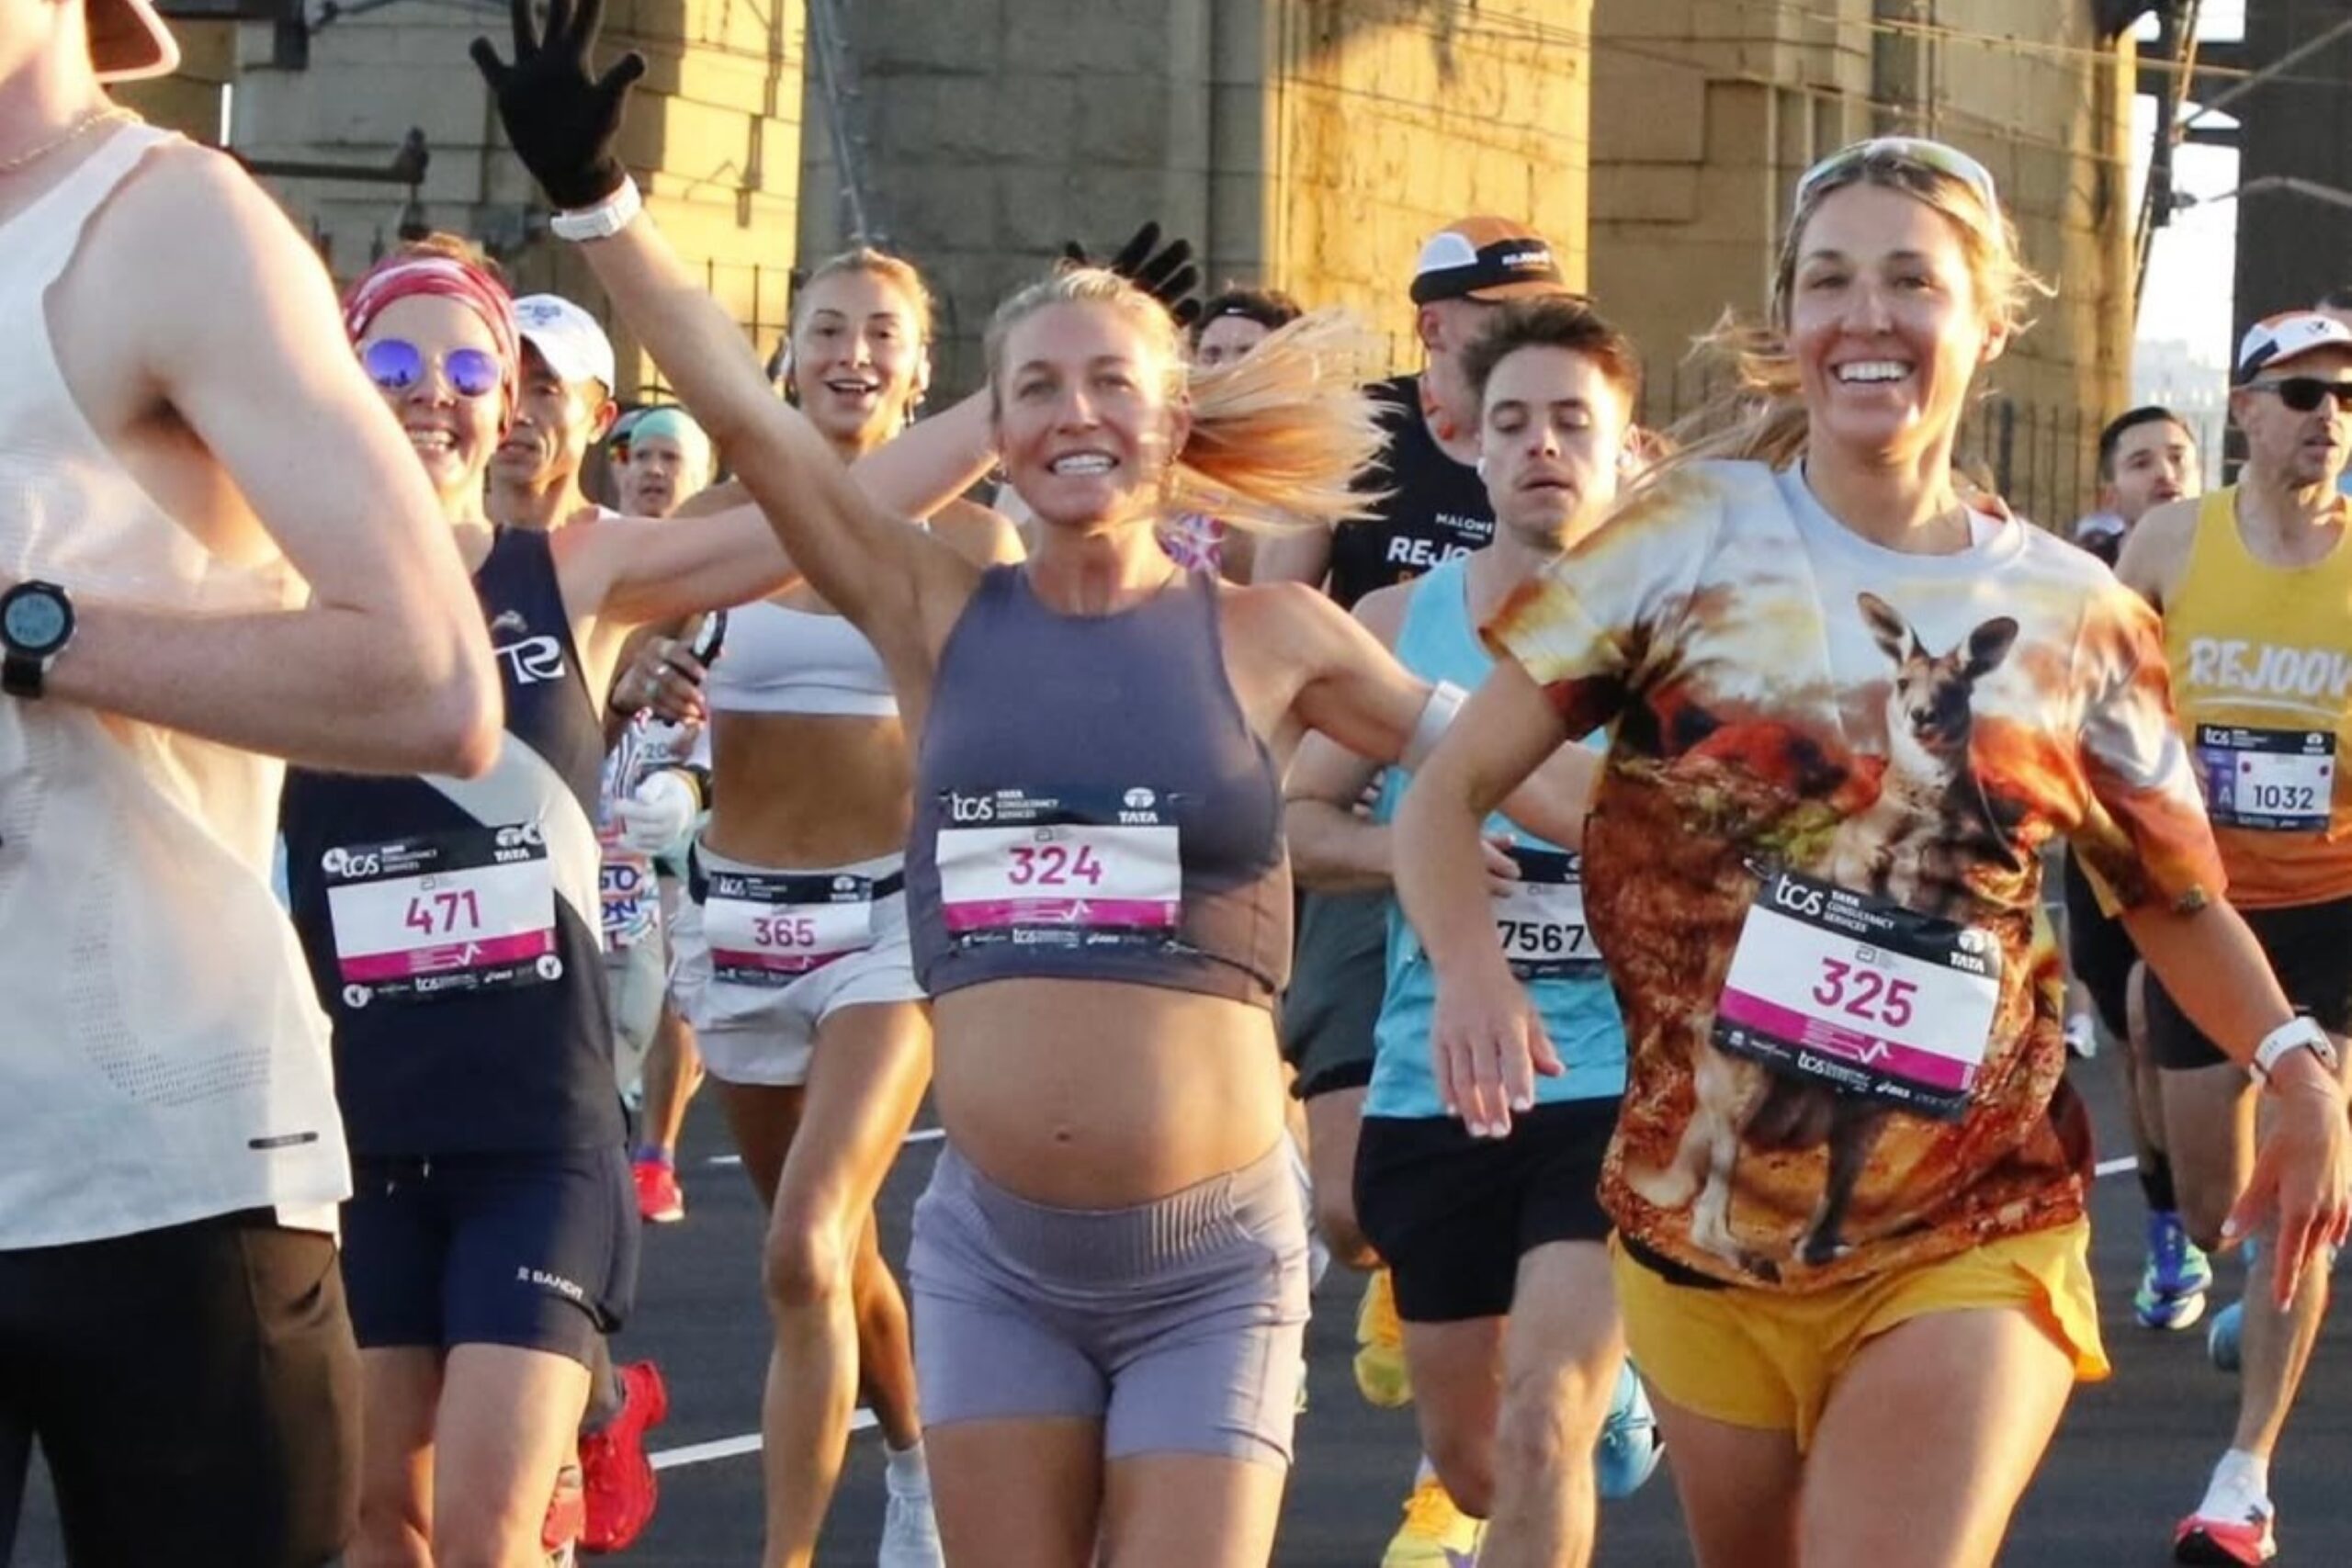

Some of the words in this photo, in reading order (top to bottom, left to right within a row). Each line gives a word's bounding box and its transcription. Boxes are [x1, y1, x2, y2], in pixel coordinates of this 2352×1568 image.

[952, 793, 993, 821] tcs
[2254, 784, 2314, 810] 1032
[1118, 811, 1158, 824] TATA
[494, 848, 530, 863] TATA
[1008, 845, 1102, 886] 324
[1775, 874, 1824, 916] tcs
[405, 889, 480, 935] 471
[752, 918, 816, 947] 365
[1497, 920, 1585, 953] 7567
[1950, 951, 1985, 974] TATA
[1812, 956, 1918, 1028] 325
